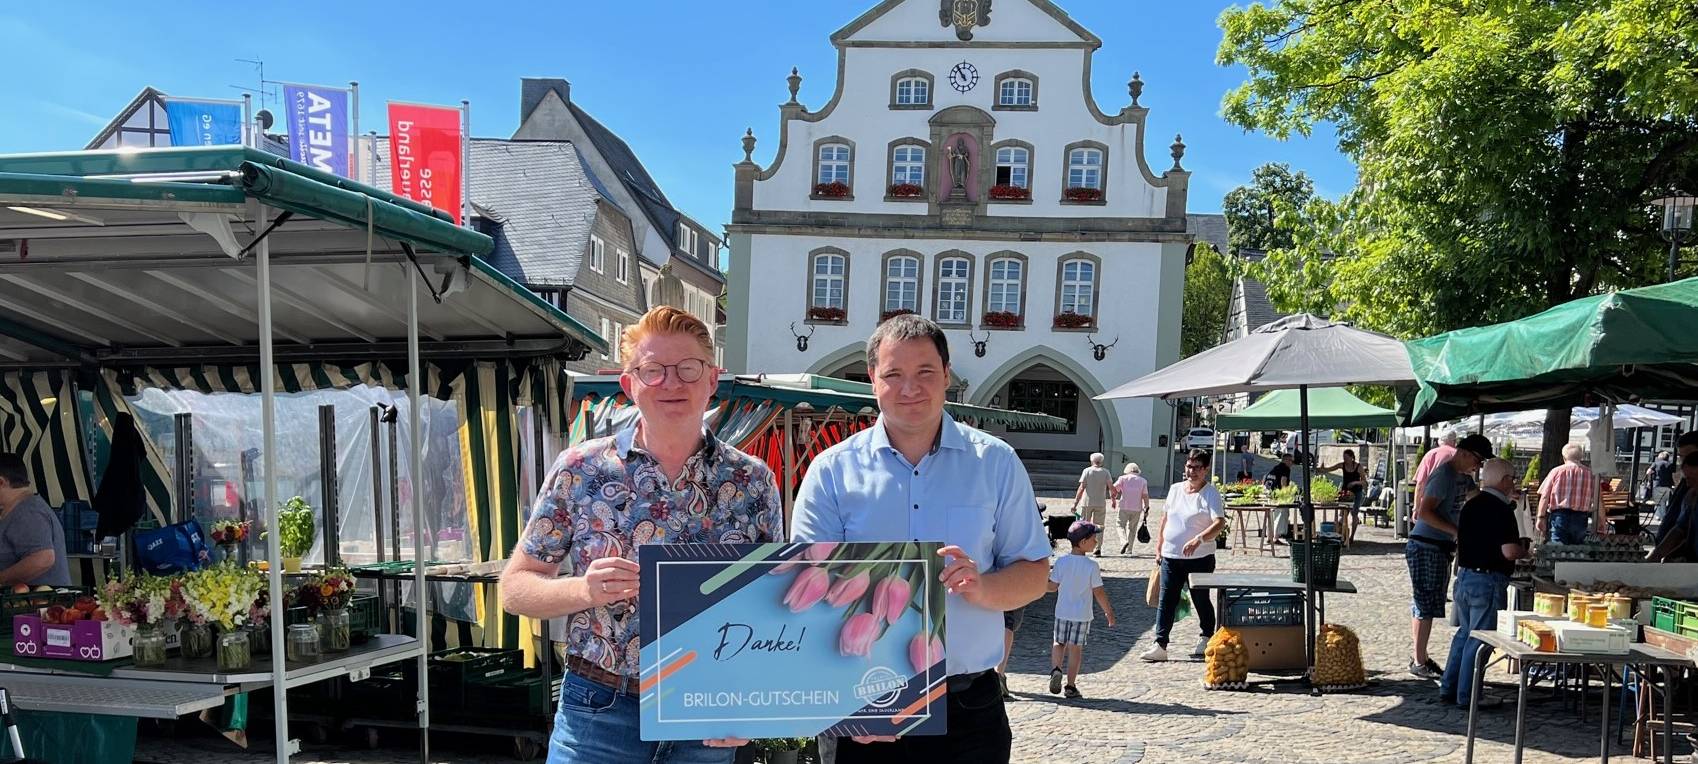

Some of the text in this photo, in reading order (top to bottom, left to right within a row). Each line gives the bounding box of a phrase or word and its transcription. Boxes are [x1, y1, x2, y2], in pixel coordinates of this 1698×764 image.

[713, 622, 806, 661] Danke!
[857, 677, 905, 697] BRILON
[683, 690, 840, 708] BRILON-GUTSCHEIN
